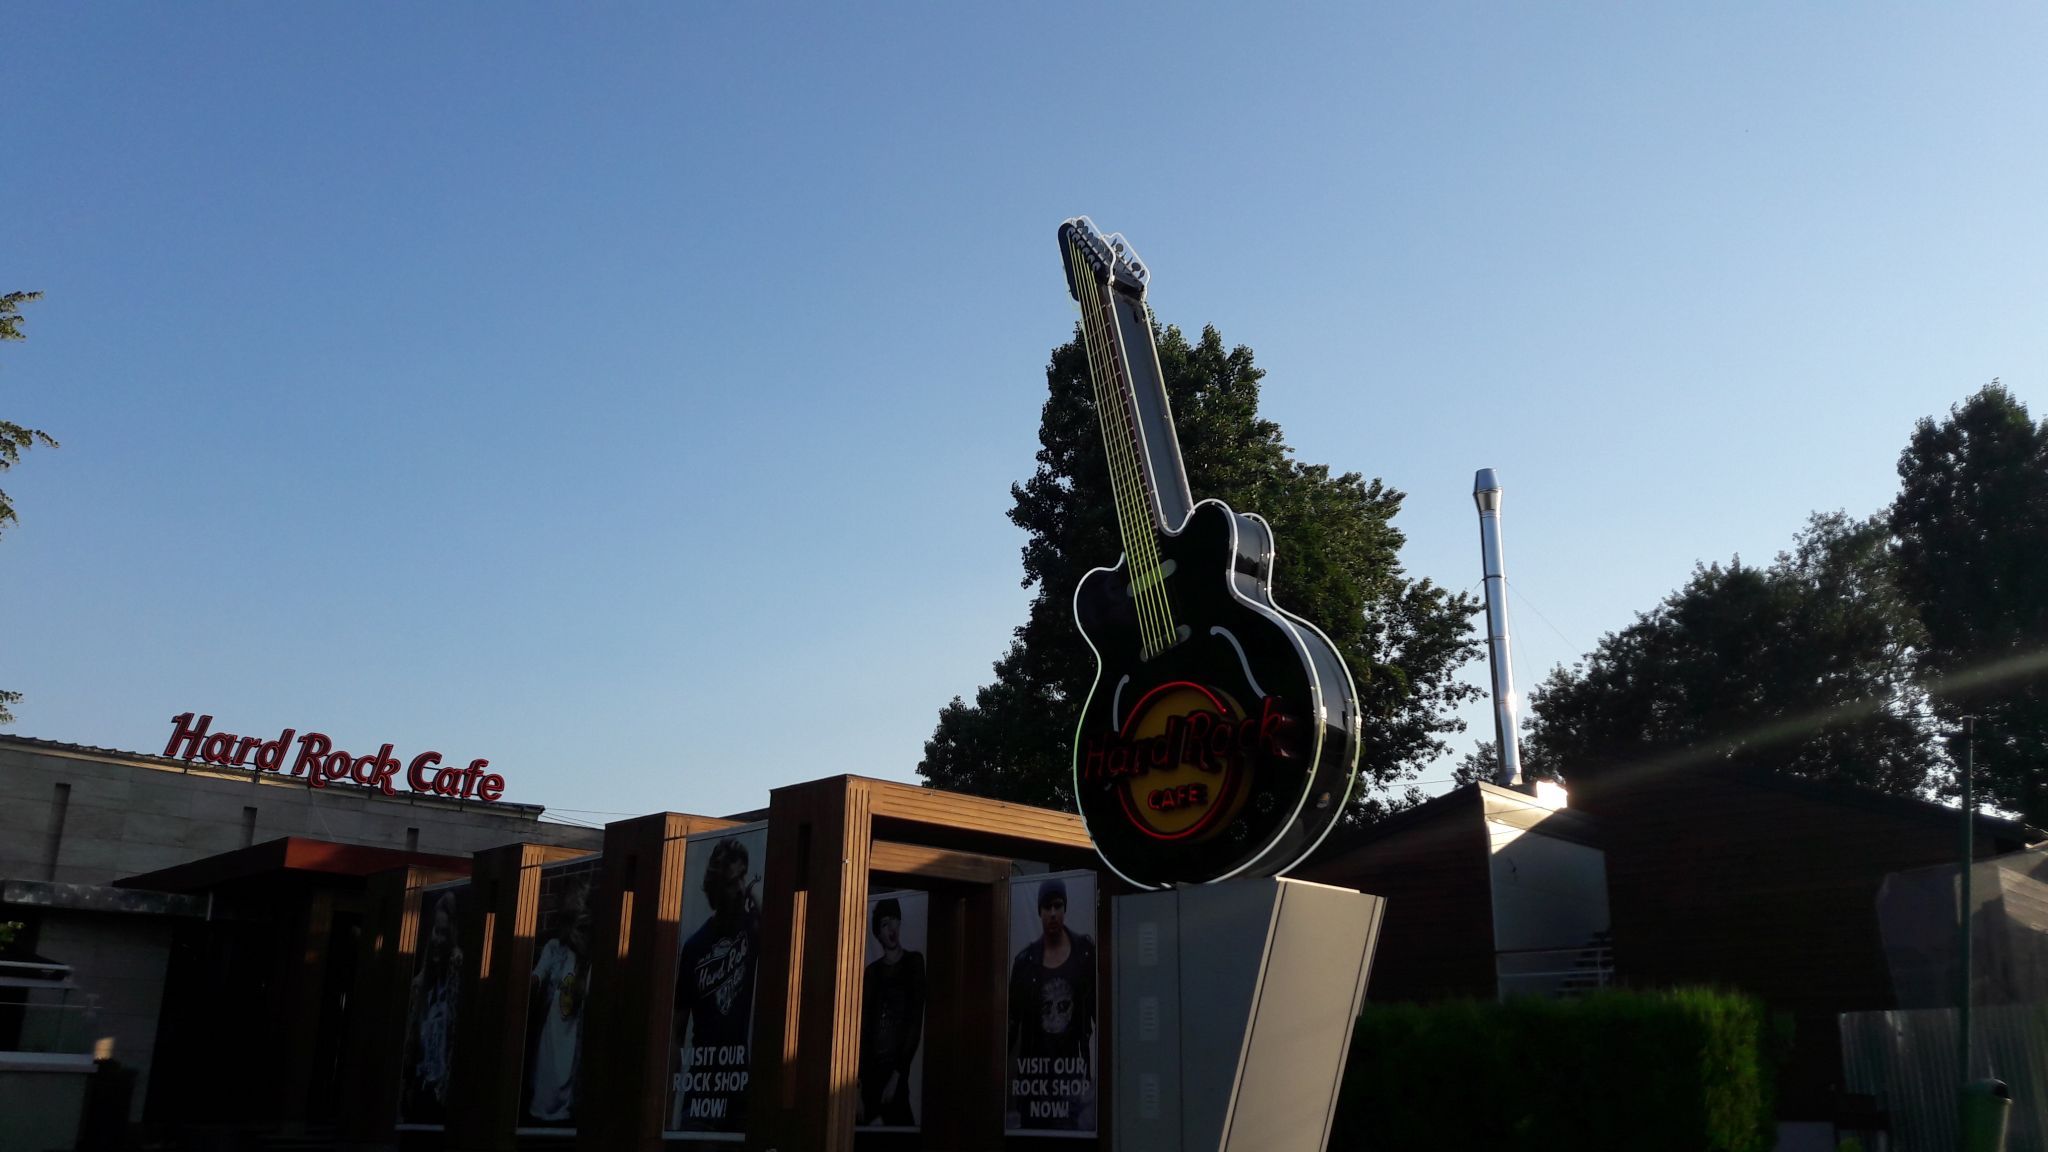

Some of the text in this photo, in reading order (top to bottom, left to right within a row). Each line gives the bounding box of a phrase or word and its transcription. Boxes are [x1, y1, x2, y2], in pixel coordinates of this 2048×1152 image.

[1084, 695, 1285, 784] Hard Rock
[163, 712, 505, 801] Hard Rock Cafe
[1148, 784, 1206, 811] CAFE
[680, 1044, 746, 1067] VISIT OUR
[1017, 1056, 1085, 1075] VISIT OUR
[672, 1071, 749, 1092] ROCK SHOP
[1012, 1079, 1090, 1096] ROCK SHOP
[690, 1097, 728, 1118] NOW!
